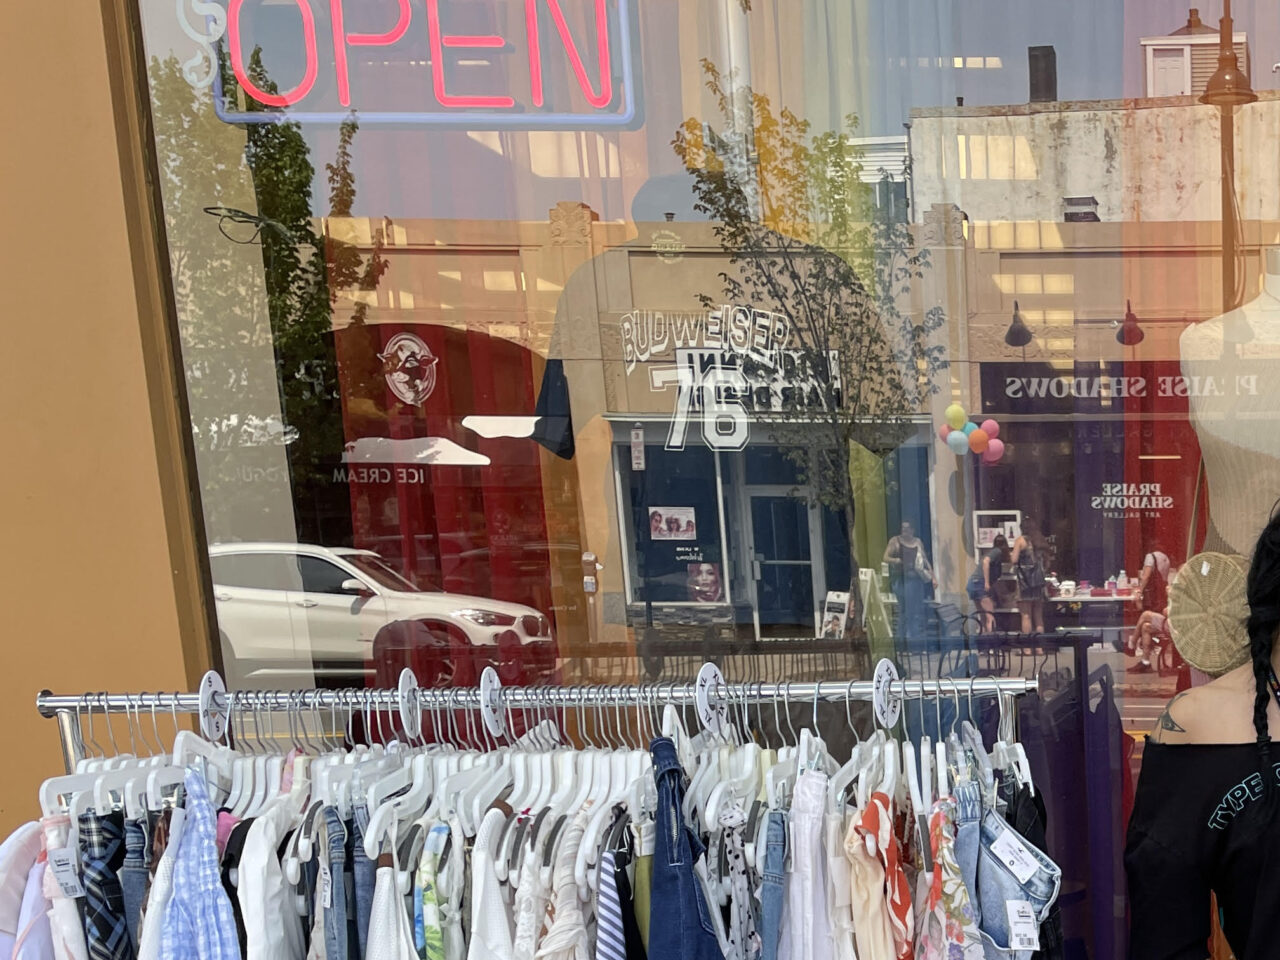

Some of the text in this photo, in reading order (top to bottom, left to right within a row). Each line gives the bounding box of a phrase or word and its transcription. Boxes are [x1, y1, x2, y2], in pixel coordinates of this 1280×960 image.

[227, 0, 612, 108] OPEN
[620, 304, 790, 376] BUDWEISER
[648, 364, 751, 452] 76
[1207, 772, 1266, 831] TYPE
